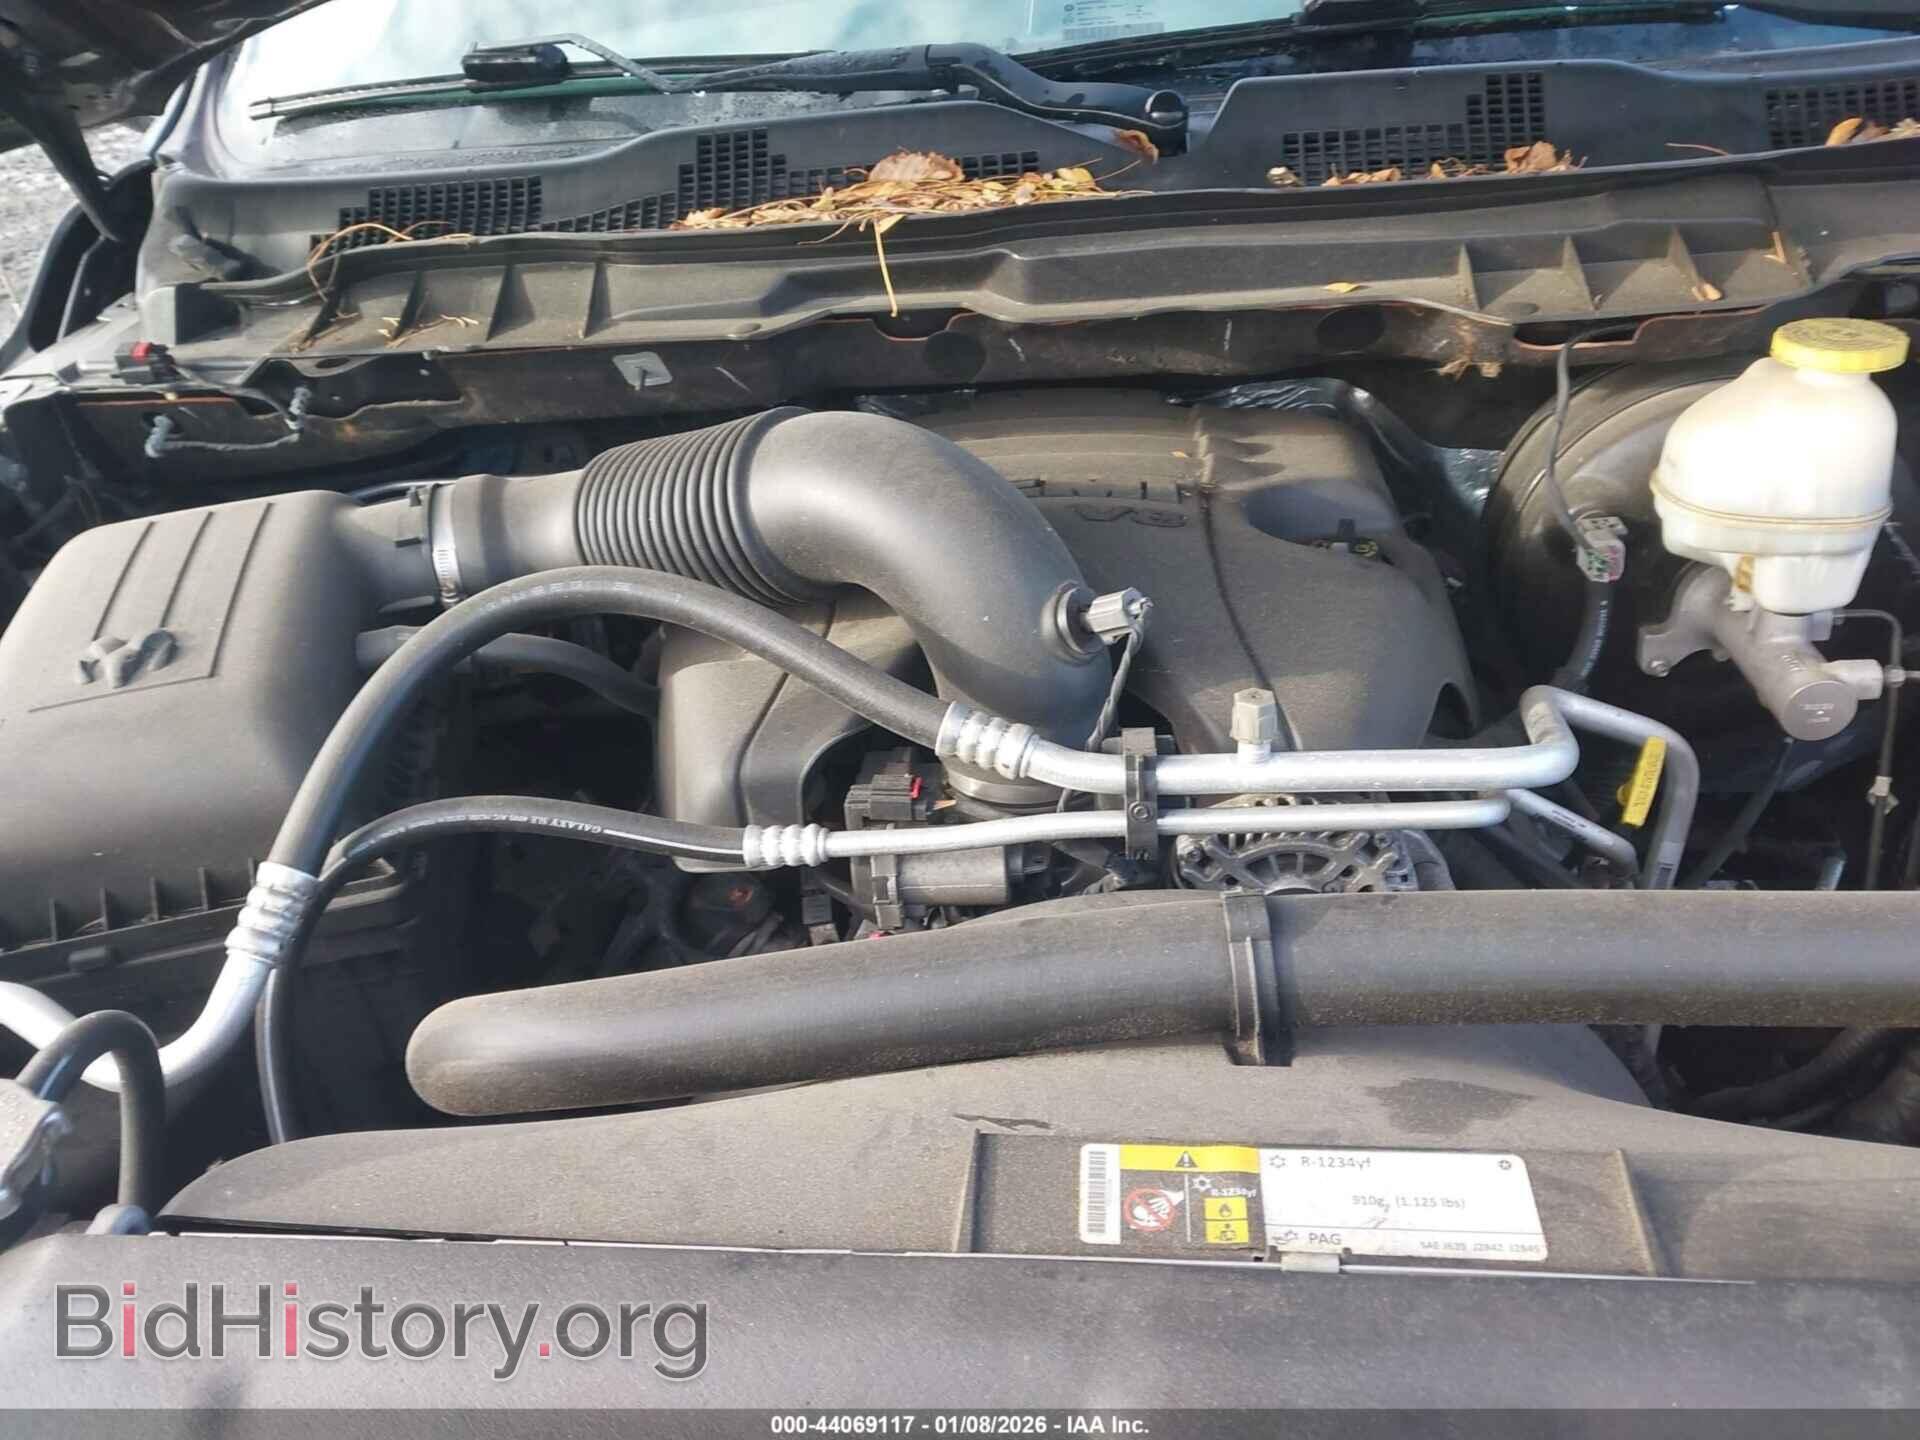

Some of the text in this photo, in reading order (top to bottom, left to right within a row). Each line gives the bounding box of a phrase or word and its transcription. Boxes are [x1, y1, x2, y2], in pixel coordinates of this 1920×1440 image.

[549, 817, 602, 834] GALAXY
[1300, 1156, 1371, 1170] R-1234yf
[1309, 1232, 1341, 1245] PAG
